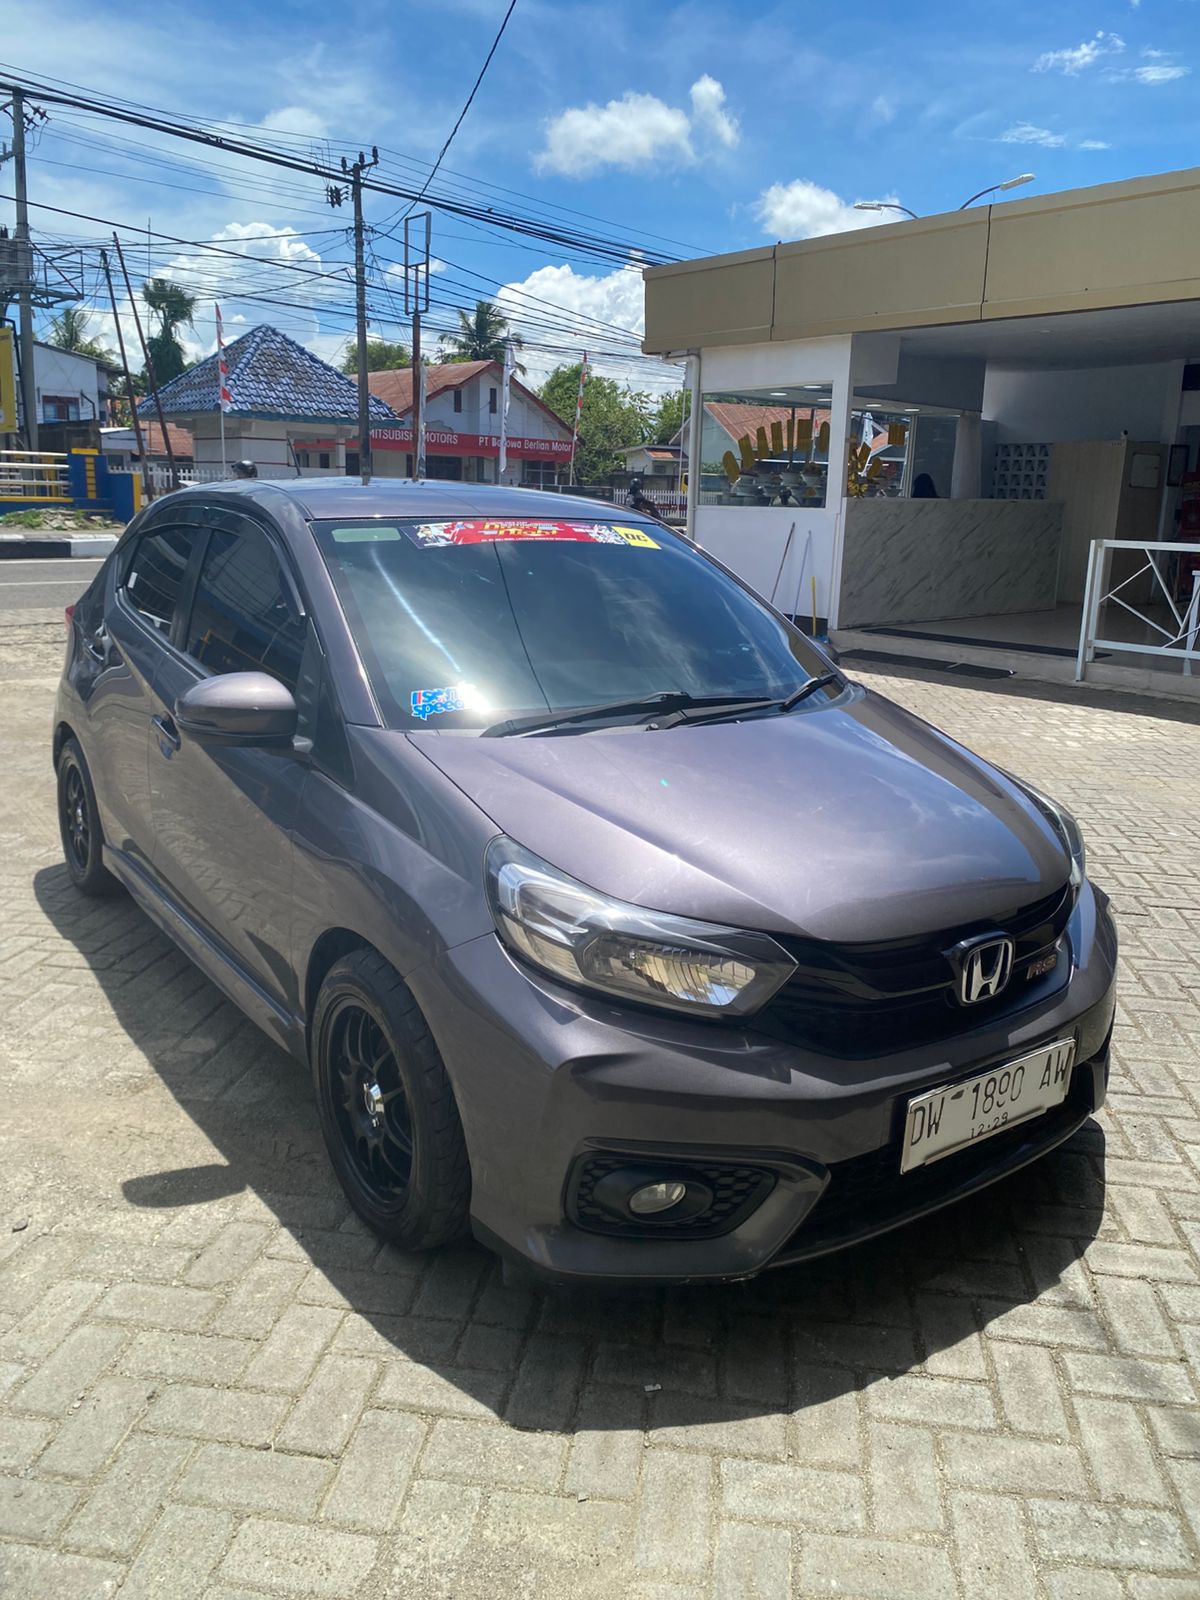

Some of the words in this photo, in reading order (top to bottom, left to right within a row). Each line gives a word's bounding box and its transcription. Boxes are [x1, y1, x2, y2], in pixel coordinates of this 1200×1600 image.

[369, 429, 413, 441] MITSUBISH
[478, 436, 489, 447] PT
[491, 437, 522, 449] Boowa
[524, 439, 550, 451] Berlian
[551, 441, 572, 452] Motor
[910, 1096, 945, 1146] DW
[971, 1065, 1025, 1121] 1890
[1039, 1046, 1073, 1090] AW
